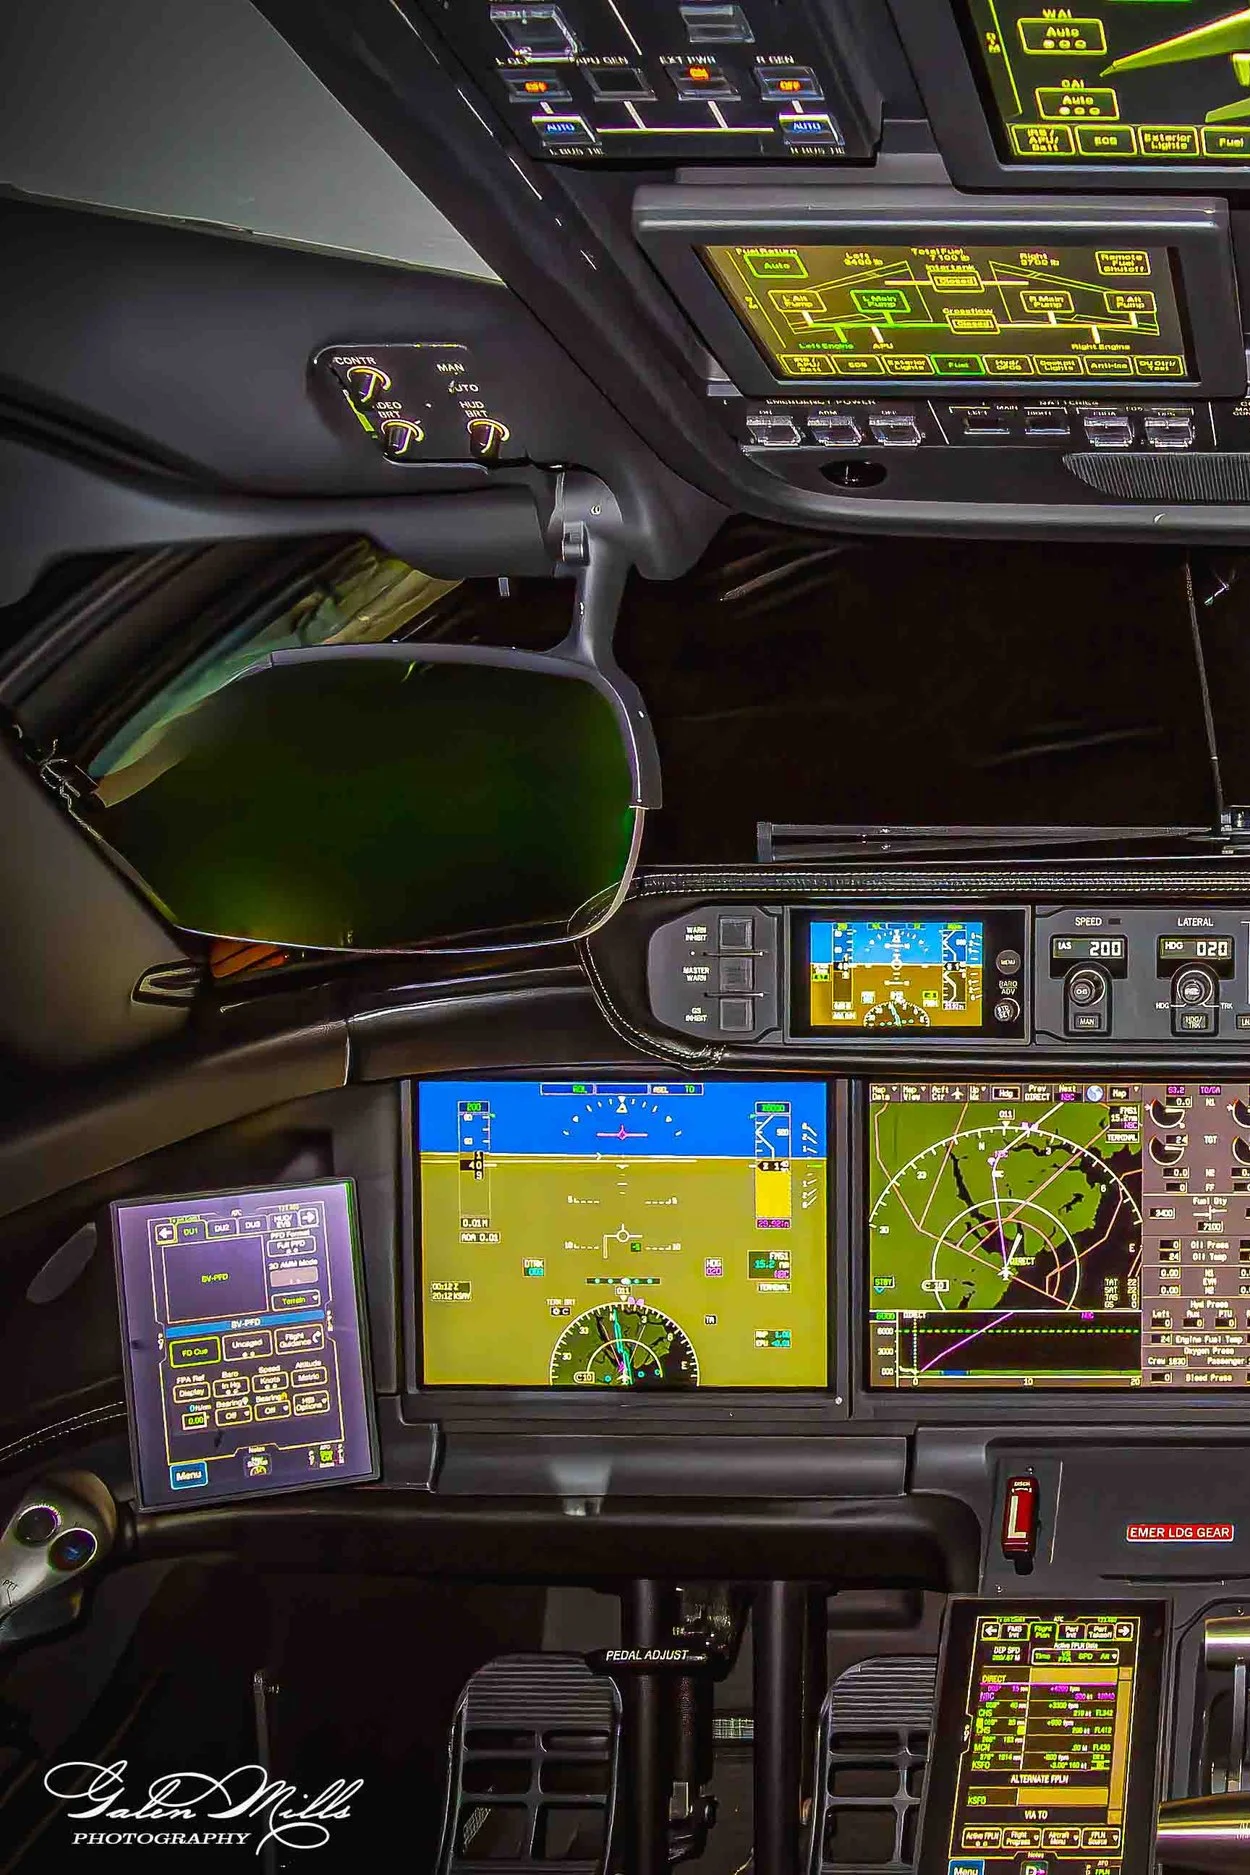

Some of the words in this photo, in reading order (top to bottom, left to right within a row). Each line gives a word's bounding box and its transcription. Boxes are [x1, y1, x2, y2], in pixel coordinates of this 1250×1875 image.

[1046, 26, 1080, 38] Auto
[1063, 95, 1094, 105] Auto
[546, 122, 575, 134] AUTO
[793, 121, 822, 133] AUTO
[764, 262, 790, 270] Auto
[437, 364, 465, 372] MAN
[461, 401, 485, 409] HUD
[1075, 917, 1102, 927] SPEED
[1178, 918, 1213, 927] LATERAL
[1058, 941, 1071, 950] IAS
[1089, 941, 1121, 956] 200
[1165, 942, 1183, 950] HDG
[1197, 941, 1227, 956] 020
[999, 1089, 1013, 1098] Hdg
[1025, 1092, 1050, 1100] DIRECT
[1177, 1098, 1190, 1106] 0.0
[1176, 1136, 1186, 1144] 24
[1046, 1147, 1051, 1155] 3
[1101, 1184, 1106, 1192] 6
[184, 1228, 198, 1236] DU1
[1153, 1310, 1170, 1318] Left
[182, 1349, 193, 1357] FD
[681, 1361, 688, 1369] E
[1130, 1378, 1140, 1386] 20
[188, 1416, 204, 1424] 0.00
[177, 1470, 201, 1481] Menu
[1007, 1496, 1027, 1538] L
[1130, 1527, 1165, 1538] EMER
[1169, 1527, 1193, 1538] LDG
[1197, 1528, 1229, 1537] GEAR
[606, 1650, 642, 1661] PEDAL
[644, 1650, 689, 1660] ADJUST
[1038, 1811, 1048, 1819] TO
